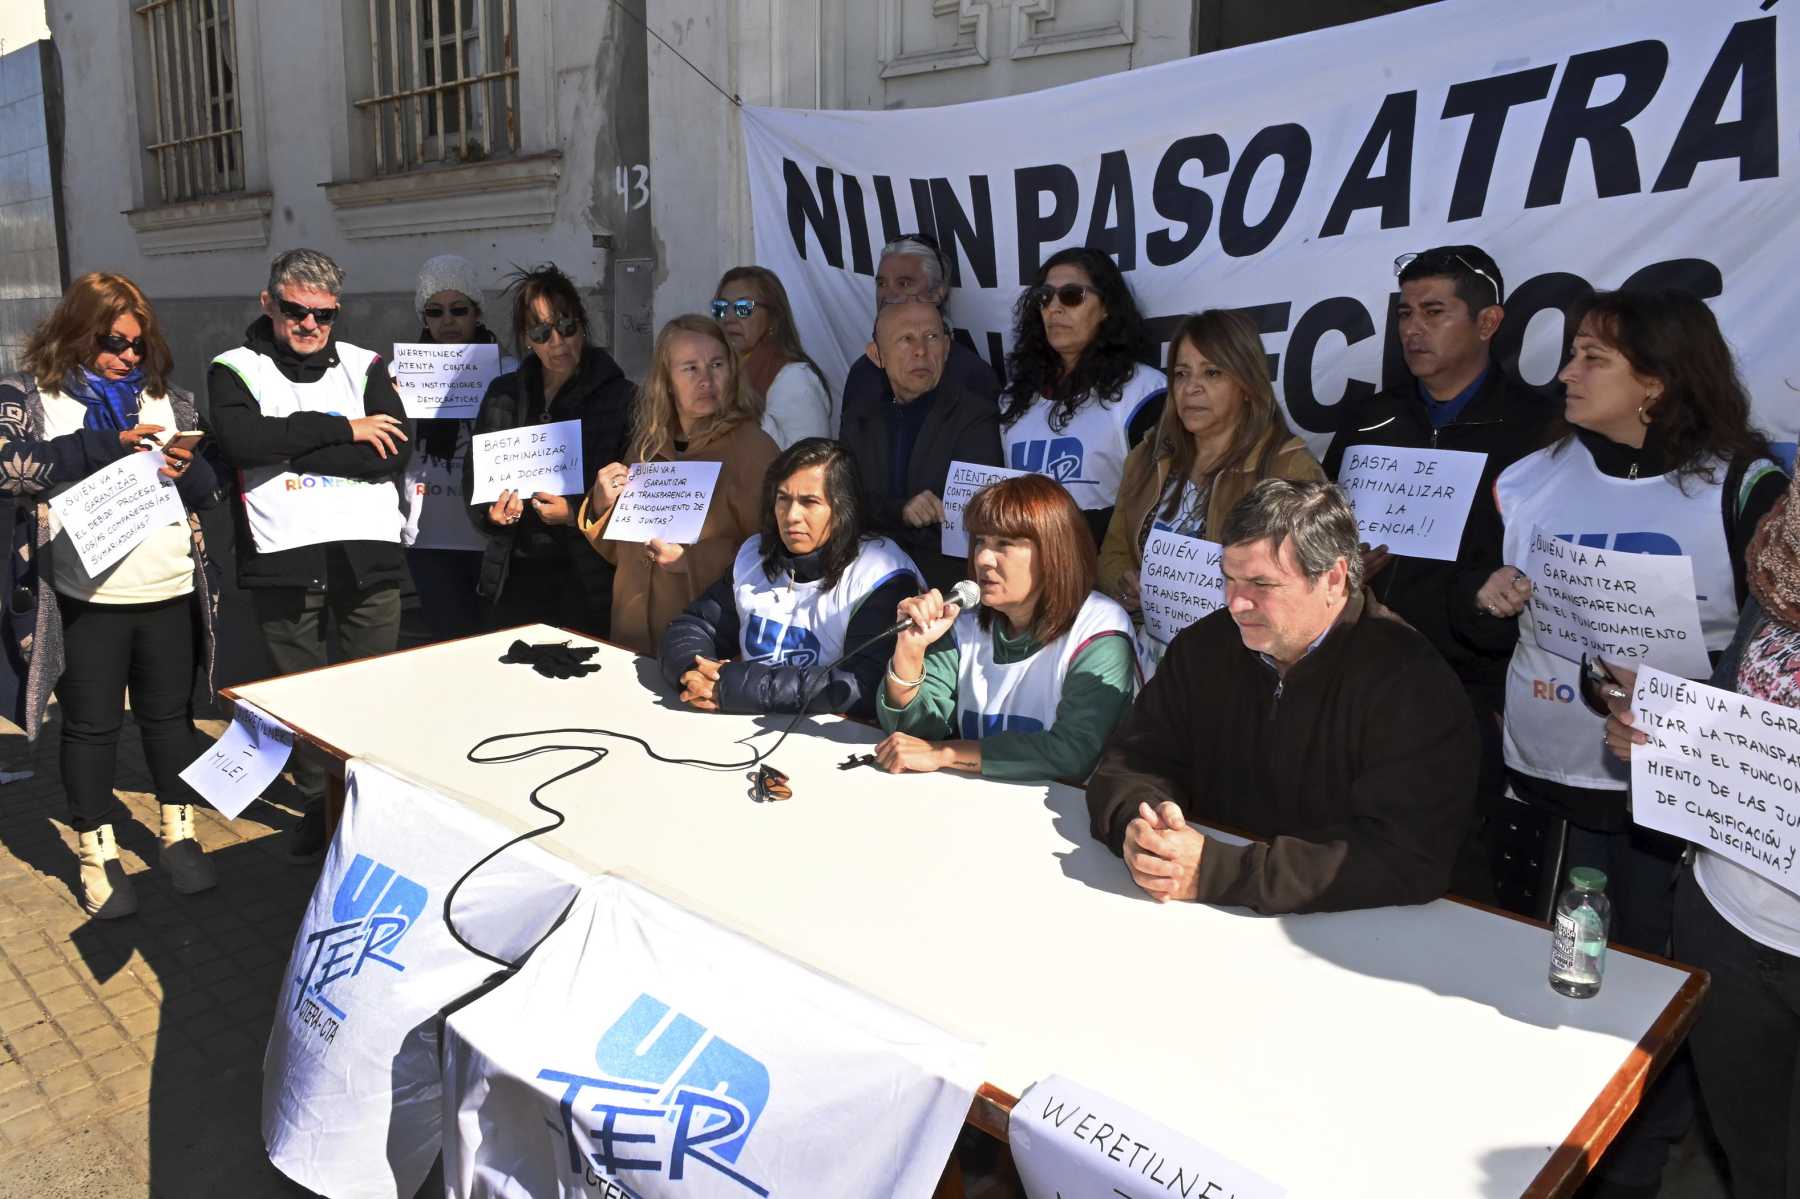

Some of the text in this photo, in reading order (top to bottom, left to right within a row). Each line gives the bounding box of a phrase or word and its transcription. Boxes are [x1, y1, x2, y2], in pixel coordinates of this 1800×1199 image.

[615, 164, 649, 214] 43
[782, 157, 872, 277] NI
[1014, 122, 1312, 288] PASO
[398, 361, 478, 371] ATENTA CONTRA
[399, 380, 482, 389] LAS INSTITUCIONES
[484, 433, 548, 451] BASTA DE
[494, 445, 567, 465] CRIMINALIZAR
[118, 467, 124, 475] A
[488, 457, 578, 483] A LA DOCENCIA!!
[1350, 454, 1438, 475] BASTA DE
[84, 473, 138, 513] GARANTIZAR
[638, 491, 692, 500] TRANSPARENCIA
[643, 479, 688, 488] GARANTIZAR
[1343, 477, 1456, 499] CRIMINALIZAR
[75, 530, 87, 540] EL
[116, 484, 157, 507] PROCESO
[633, 503, 690, 512] FUNCIONAMIENTO
[693, 503, 704, 511] DE
[638, 515, 674, 525] JUNTAS?
[1350, 500, 1408, 515] A LA
[1357, 516, 1435, 538] CENCIA!!
[1570, 550, 1588, 565] VA
[1594, 554, 1607, 567] A
[1147, 562, 1224, 590] GARANTIZAR
[1543, 563, 1638, 594] GARANTIZAR
[1544, 586, 1656, 618] TRANSPARENCIA
[1555, 608, 1567, 618] EL
[1571, 612, 1687, 640] FUNCIONAMIENTO
[1537, 620, 1649, 659] DE LAS JUNTAS?
[1533, 677, 1575, 704] RÍO
[1639, 708, 1688, 734] TIZAR
[1700, 726, 1721, 741] LA
[1706, 696, 1728, 713] VA
[1740, 704, 1752, 719] A
[1761, 711, 1800, 735] GAR
[1680, 744, 1702, 759] EN
[1710, 754, 1730, 768] EL
[1648, 760, 1701, 787] MIENTO
[1708, 780, 1731, 797] DE
[1737, 791, 1766, 812] LAS
[1656, 790, 1678, 805] DE
[1685, 801, 1781, 849] CLASIFICACIÓN
[1709, 826, 1793, 874] DISCIPLINA?
[1042, 1096, 1236, 1199] WERETILNE
